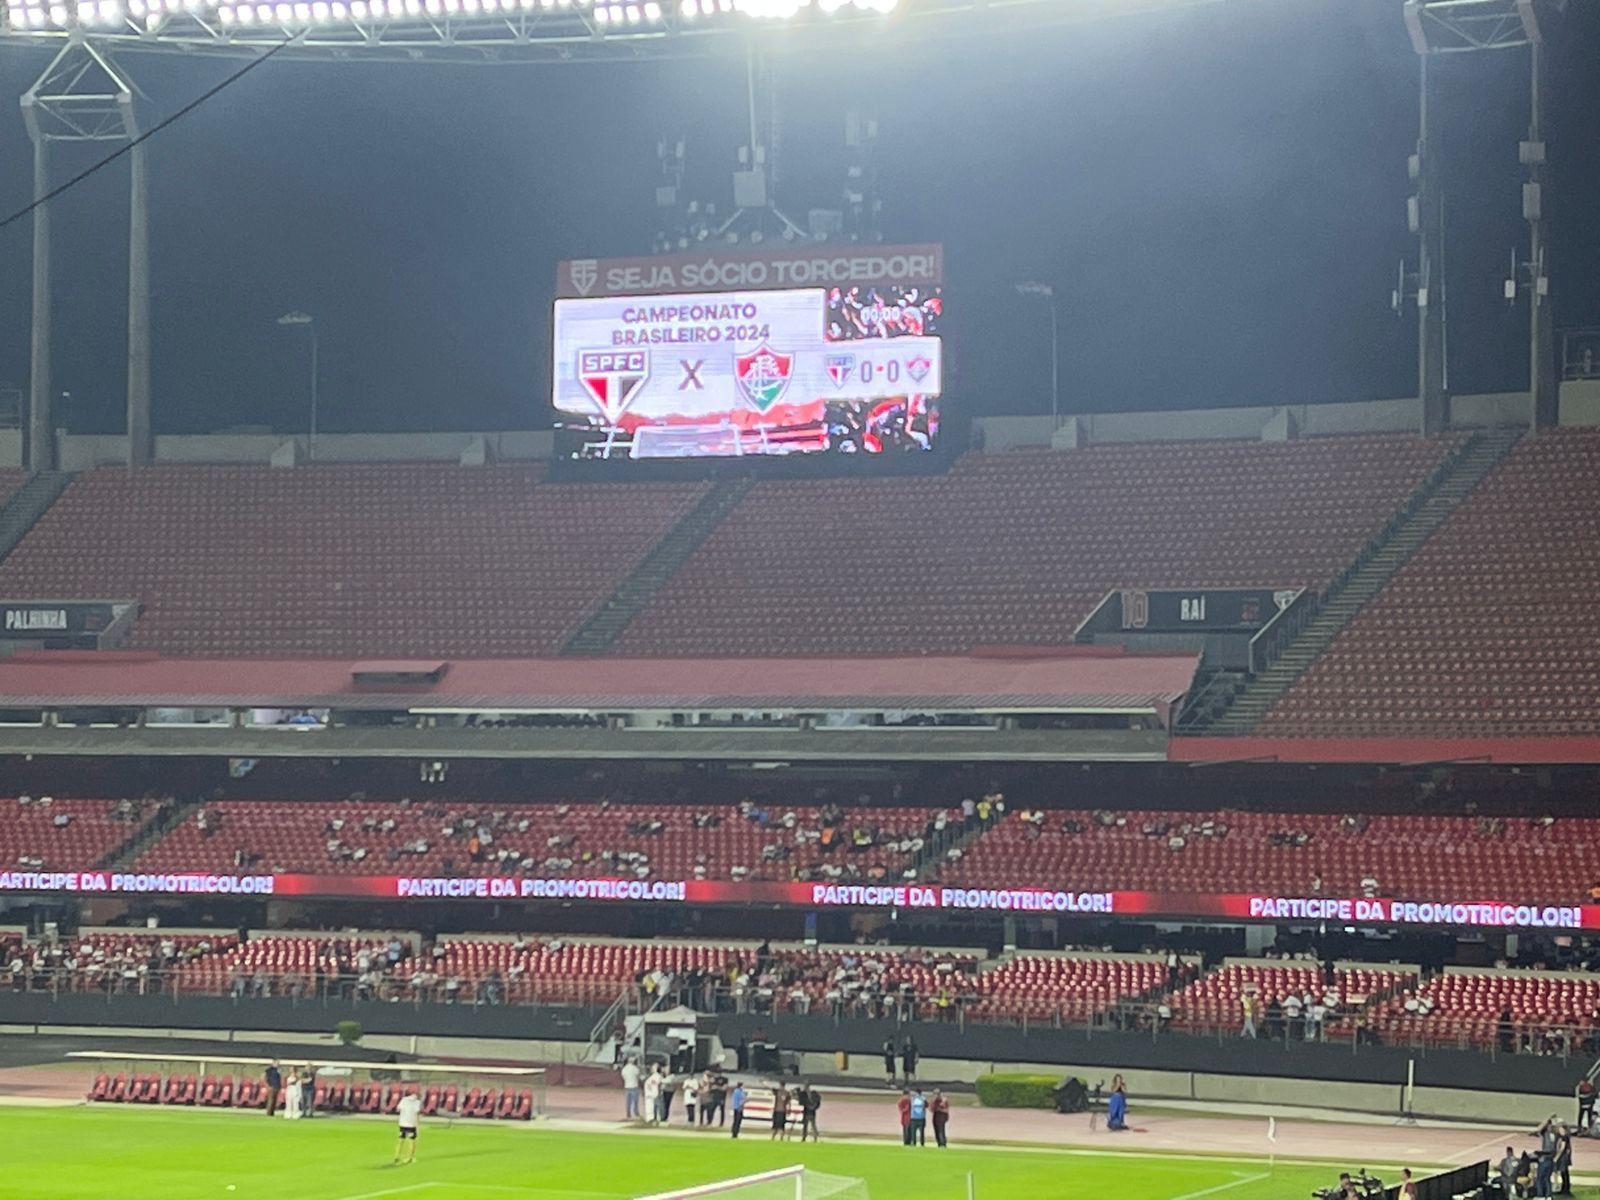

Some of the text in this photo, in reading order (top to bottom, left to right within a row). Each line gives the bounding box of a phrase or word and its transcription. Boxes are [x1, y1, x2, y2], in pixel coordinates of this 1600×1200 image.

[606, 265, 676, 290] SEJA
[681, 259, 767, 287] SÓCIO
[772, 255, 935, 284] TORCEDOR!
[622, 303, 756, 323] CAMPEONATO
[612, 324, 769, 345] BRASILEIRO 2024
[584, 354, 643, 371] SPFC
[81, 874, 105, 891] DA
[111, 874, 274, 894] PROMOTRICOLOR!
[397, 879, 686, 900] PARTICIPE DA PROMOTRICOLOR!
[812, 886, 1113, 912] PARTICIPE DA PROMOTRICOLOR!
[1250, 898, 1582, 928] PARTICIPE DA PROMOTRICOLOR!
